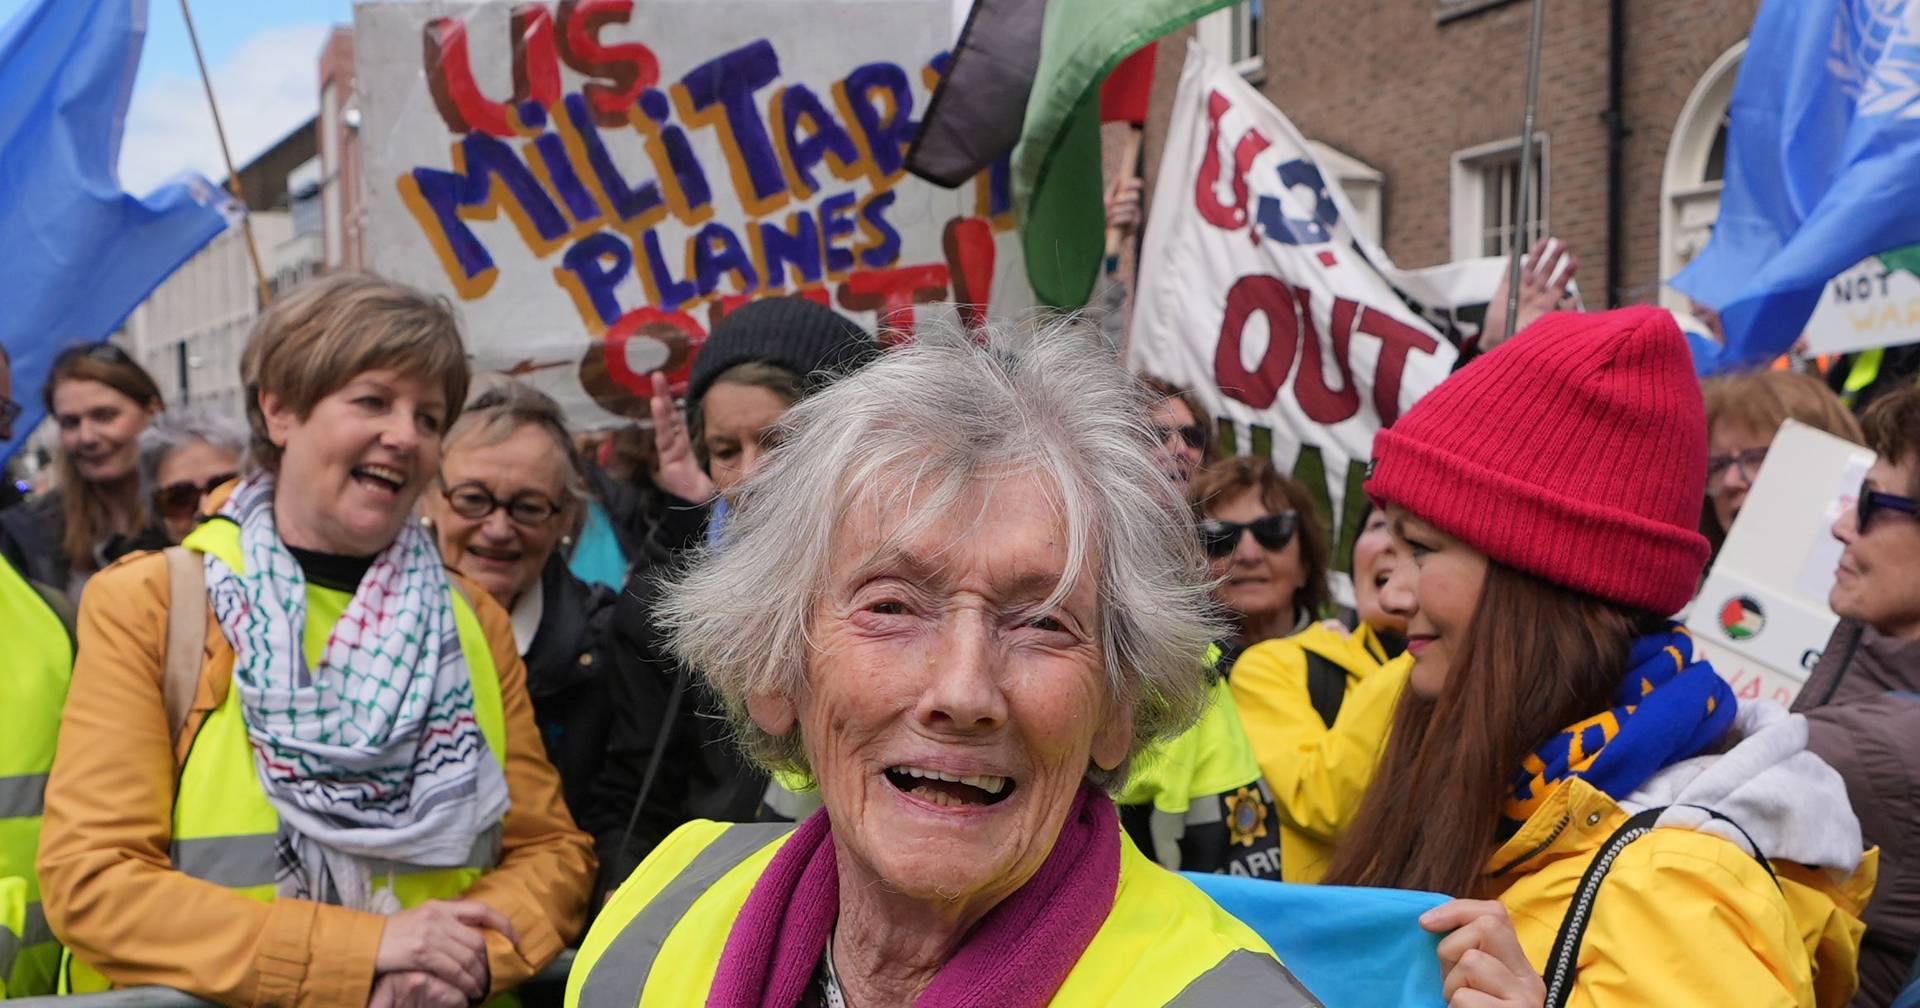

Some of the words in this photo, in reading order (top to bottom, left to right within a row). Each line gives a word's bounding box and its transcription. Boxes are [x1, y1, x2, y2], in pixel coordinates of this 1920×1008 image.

[423, 0, 660, 137] US
[555, 190, 902, 335] PLANES
[579, 216, 996, 418] OT!
[1834, 270, 1892, 304] NOT
[1214, 273, 1441, 427] OUT
